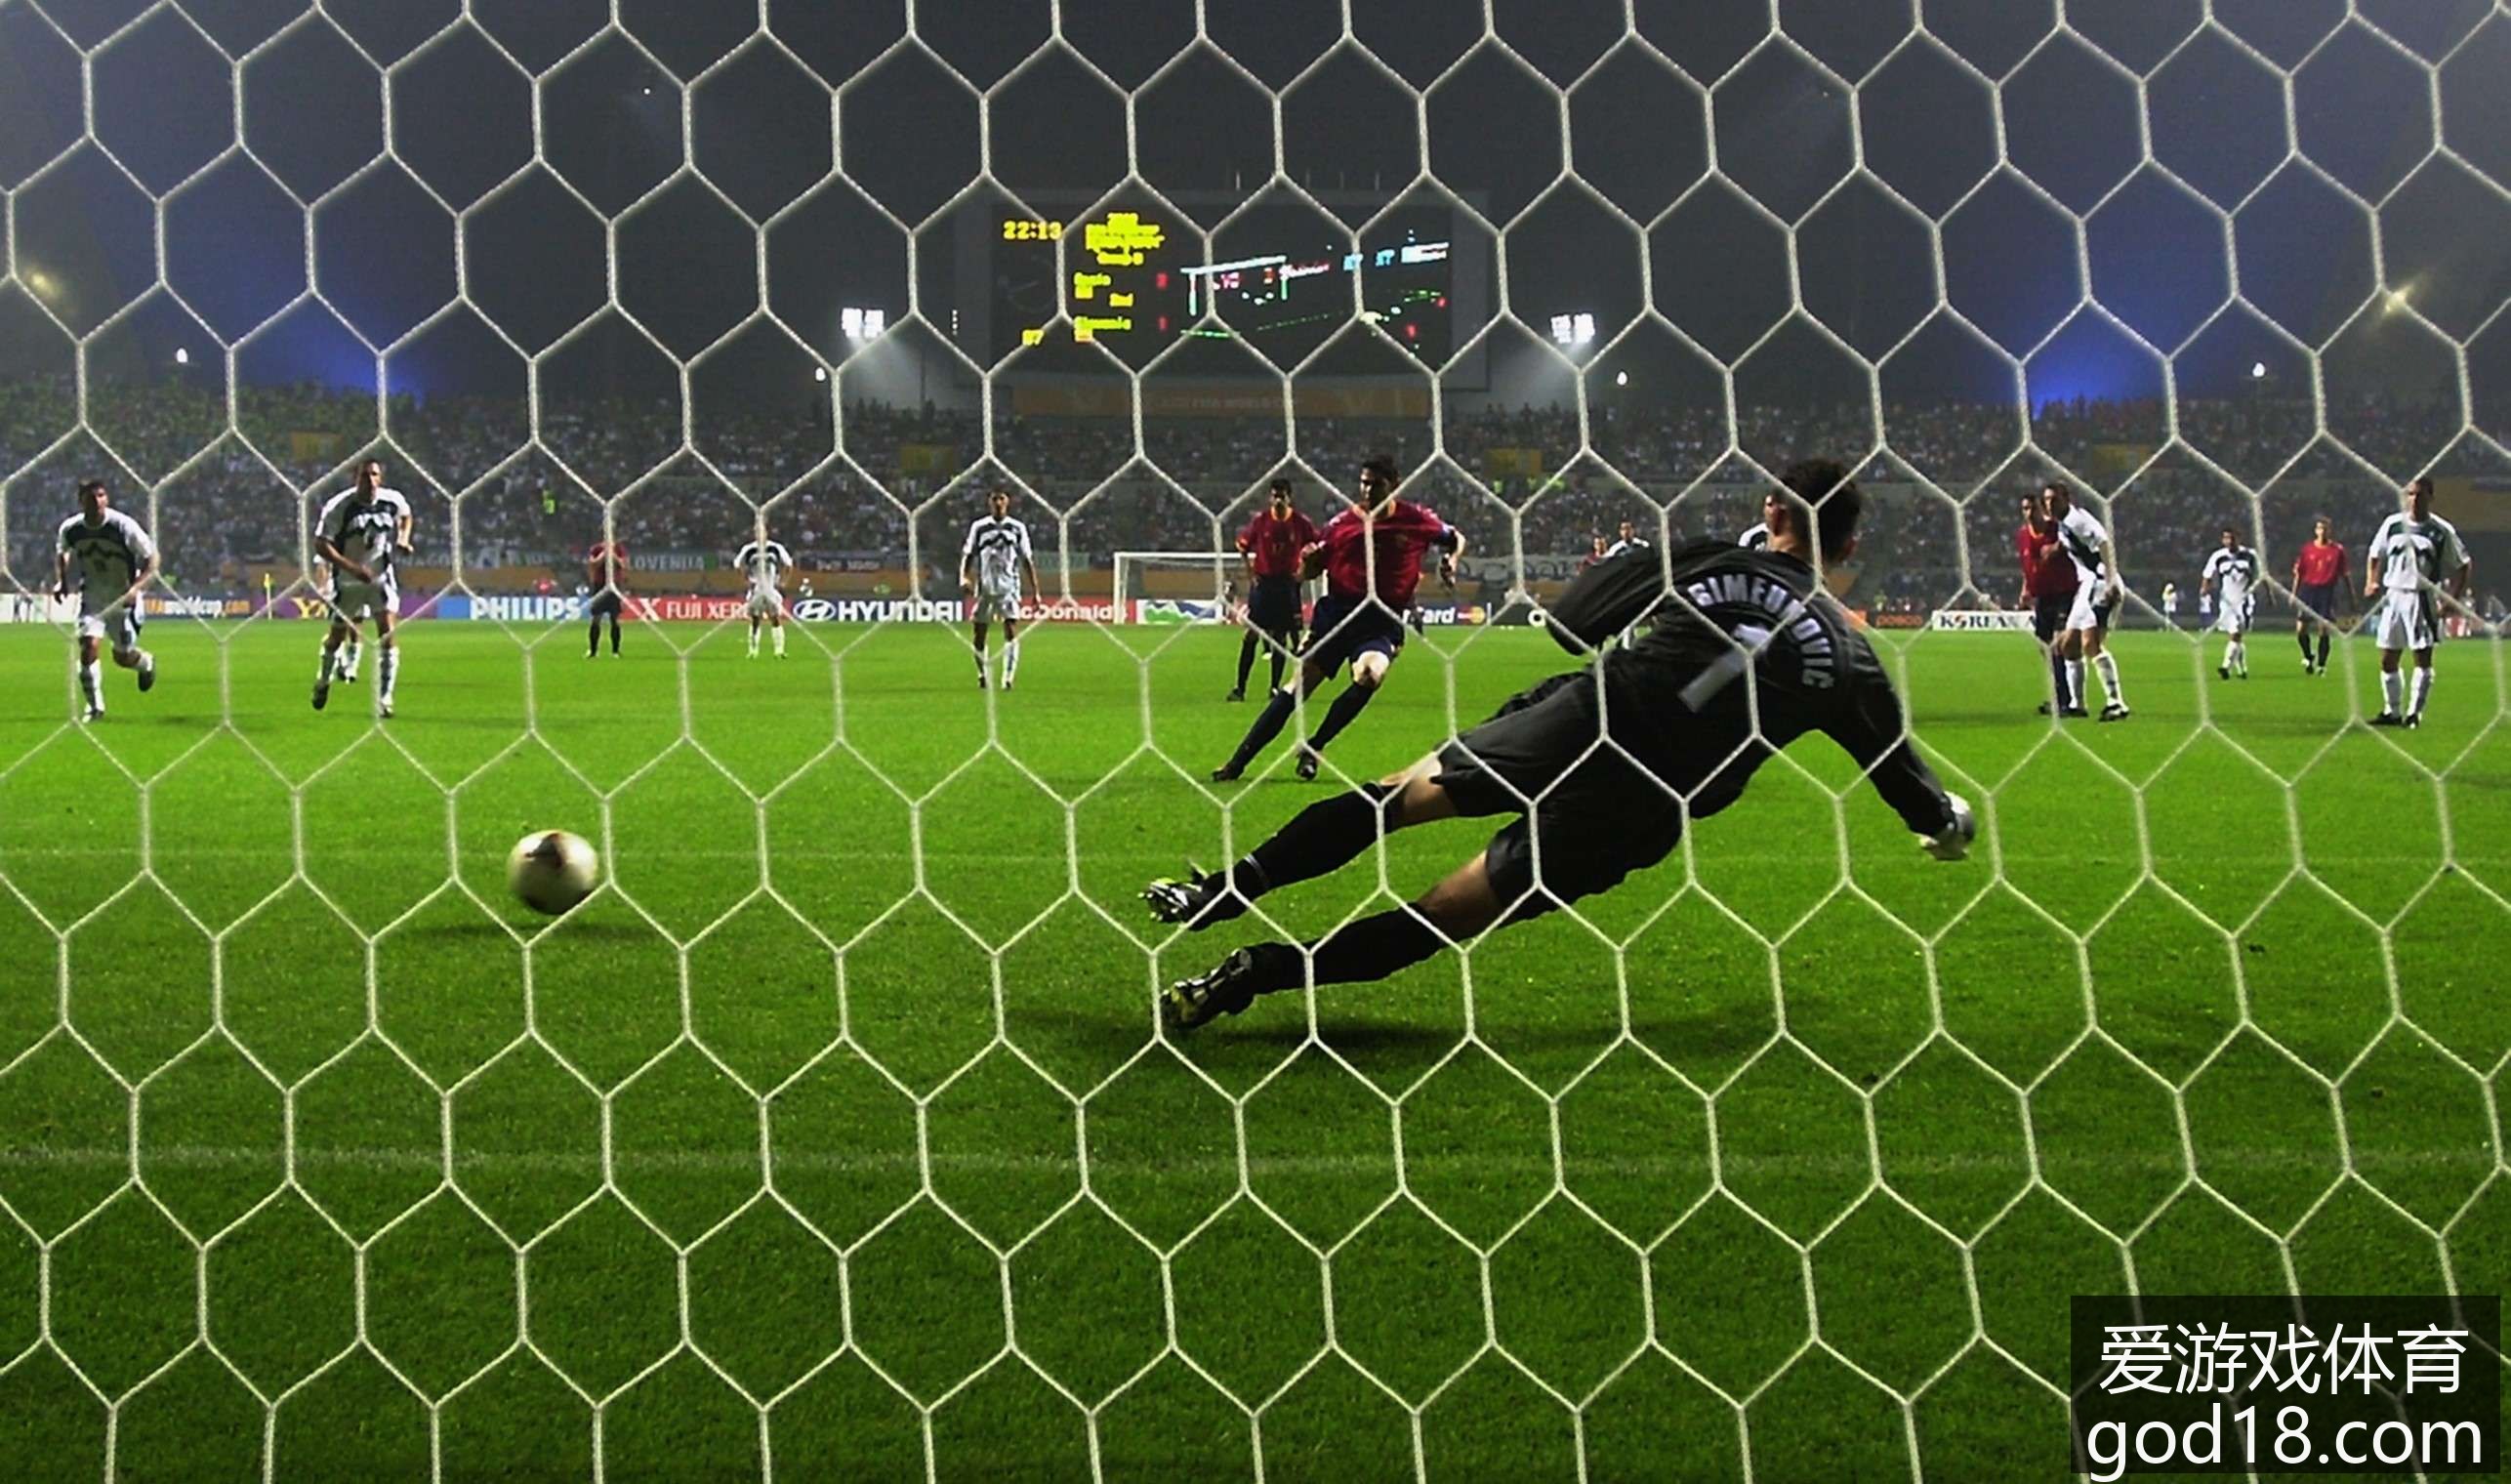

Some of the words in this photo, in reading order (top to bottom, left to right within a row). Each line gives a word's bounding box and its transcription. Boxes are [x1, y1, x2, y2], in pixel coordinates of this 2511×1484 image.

[1004, 221, 1062, 240] 22:13
[470, 596, 580, 621] PHILIPS
[667, 600, 702, 620] FUJI
[838, 600, 963, 622] HYUNDAI
